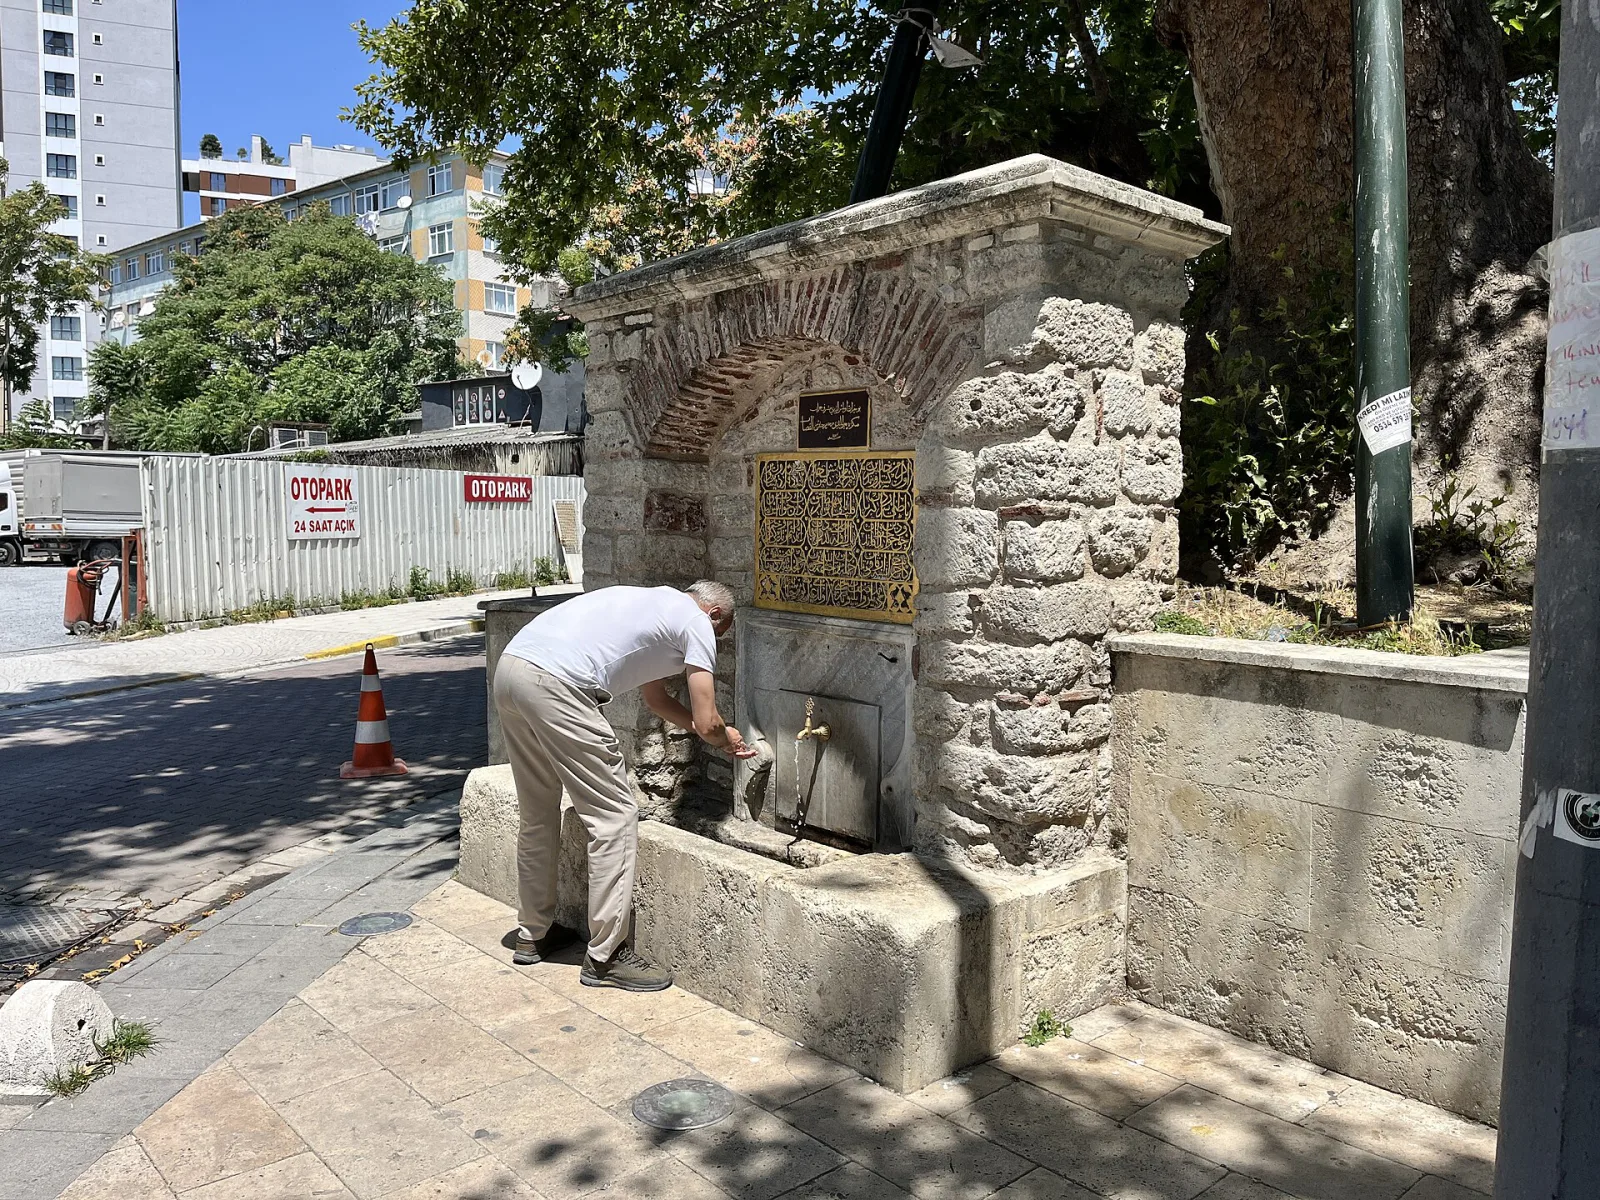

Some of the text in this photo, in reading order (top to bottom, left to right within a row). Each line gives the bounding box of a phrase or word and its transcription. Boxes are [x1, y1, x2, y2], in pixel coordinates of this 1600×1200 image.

[291, 477, 353, 500] OTOPARK
[472, 480, 527, 498] OTOPARK
[294, 519, 355, 534] 24 SAAT AÇIK
